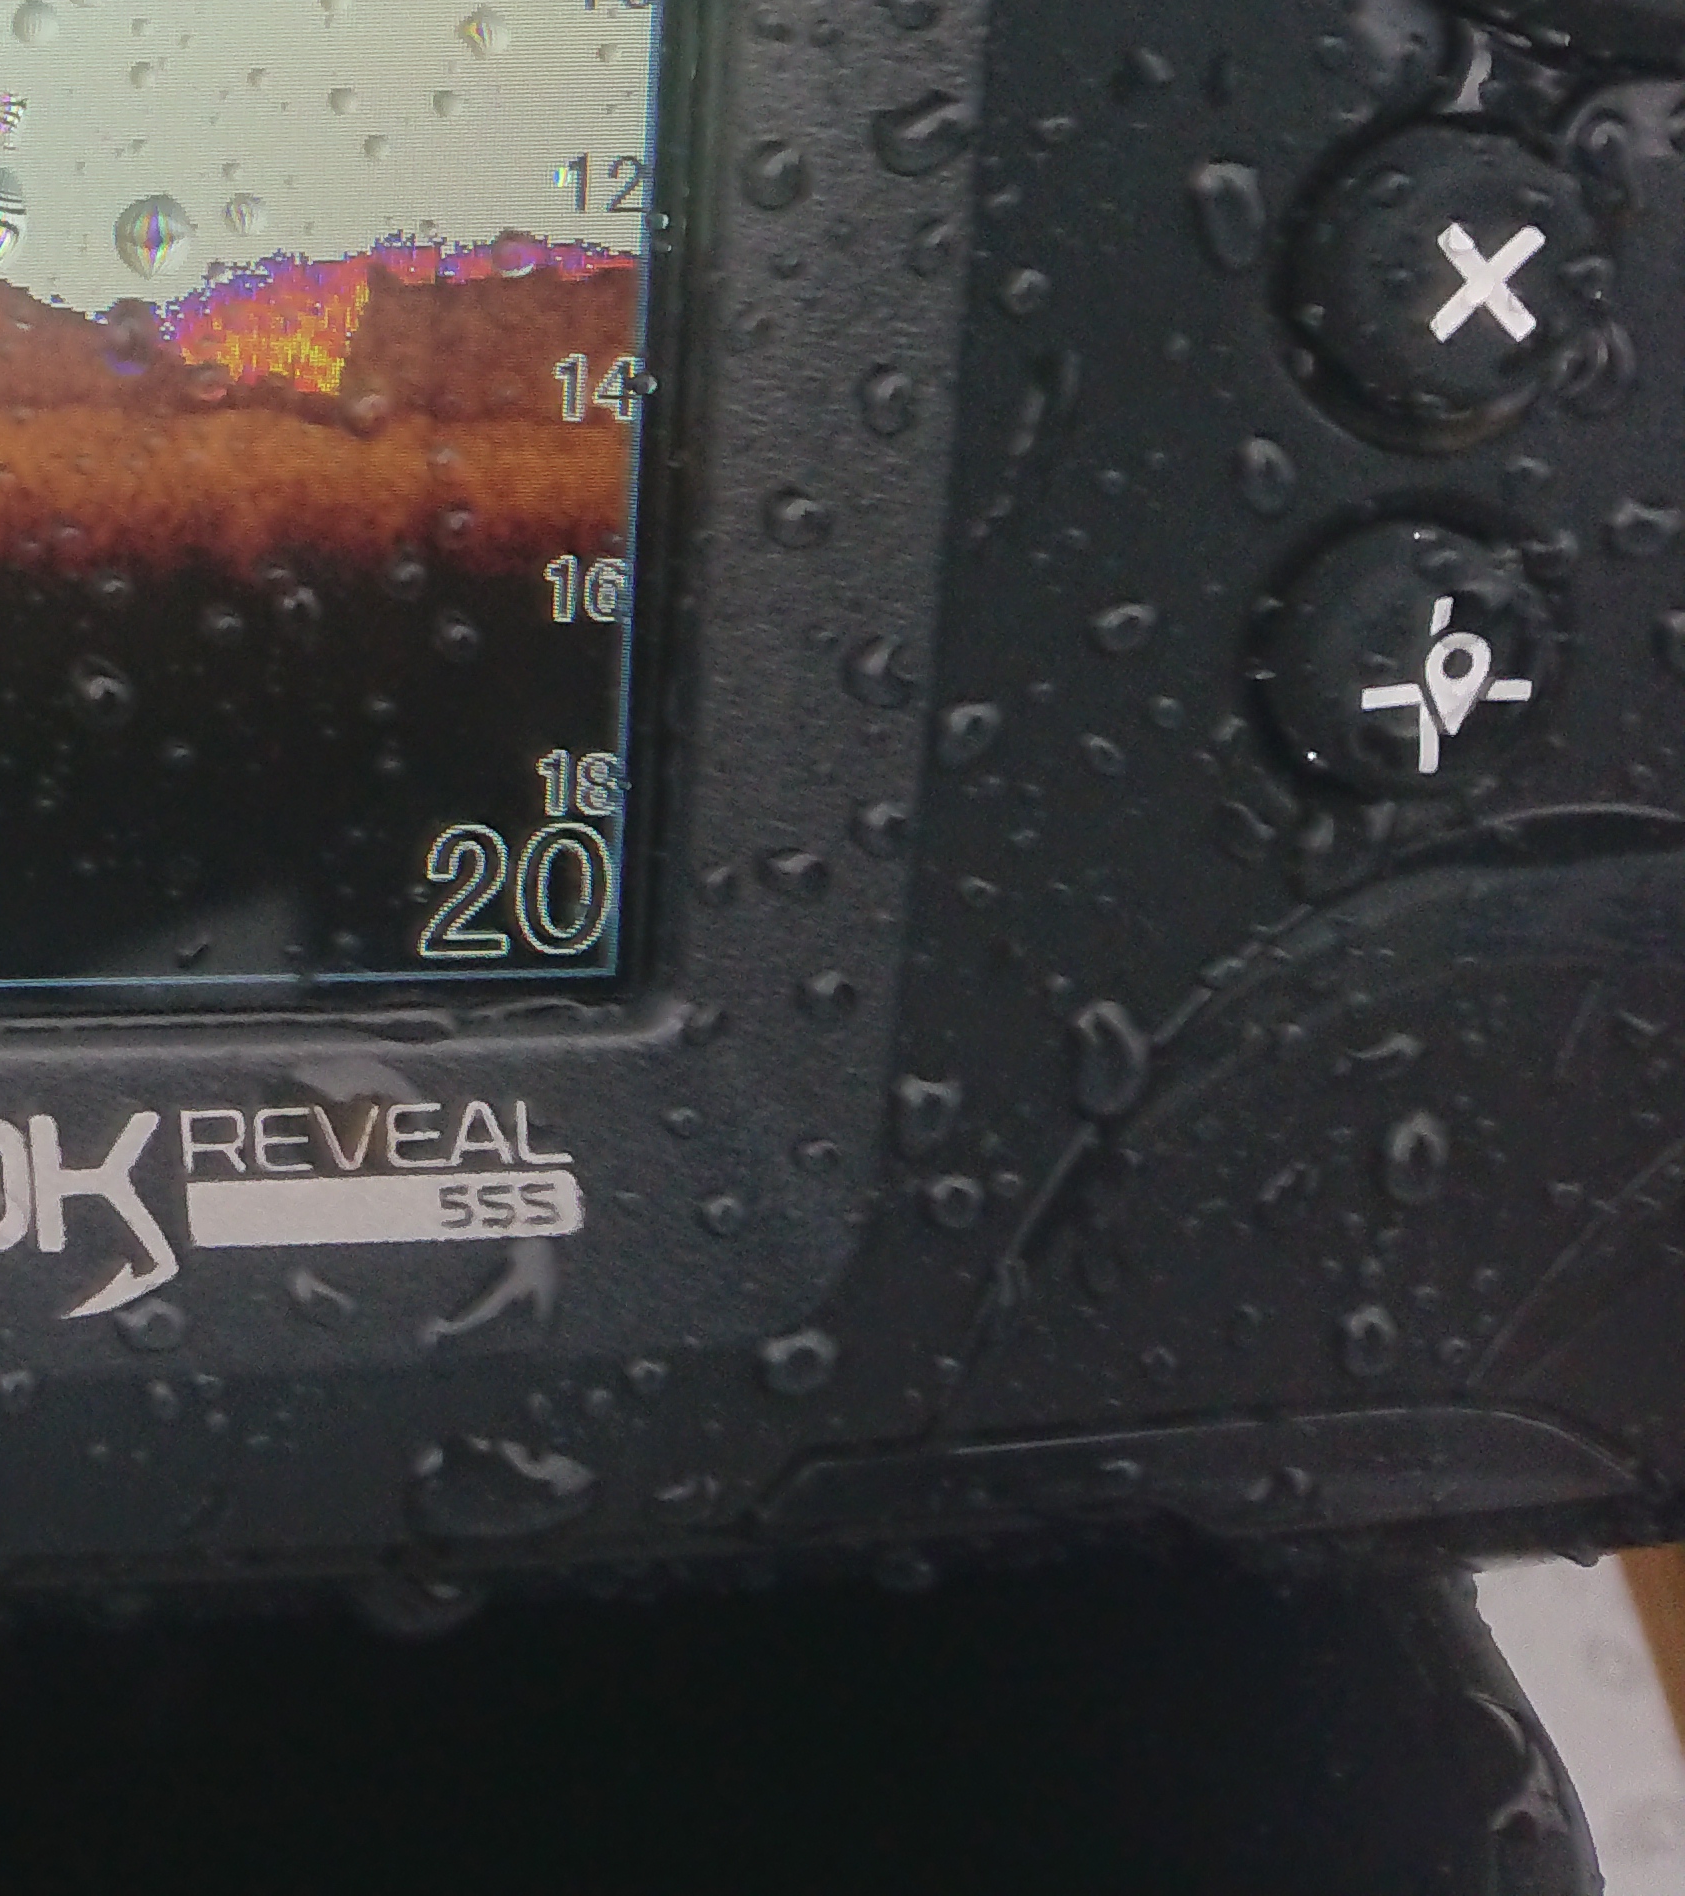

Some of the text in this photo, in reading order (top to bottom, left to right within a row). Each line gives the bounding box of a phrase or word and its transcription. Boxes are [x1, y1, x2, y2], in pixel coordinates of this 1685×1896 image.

[567, 152, 648, 214] 12
[552, 352, 645, 423] 14
[543, 554, 631, 623] 16
[535, 748, 625, 817] 18
[416, 821, 619, 959] 20
[181, 1100, 576, 1173] REVEAL
